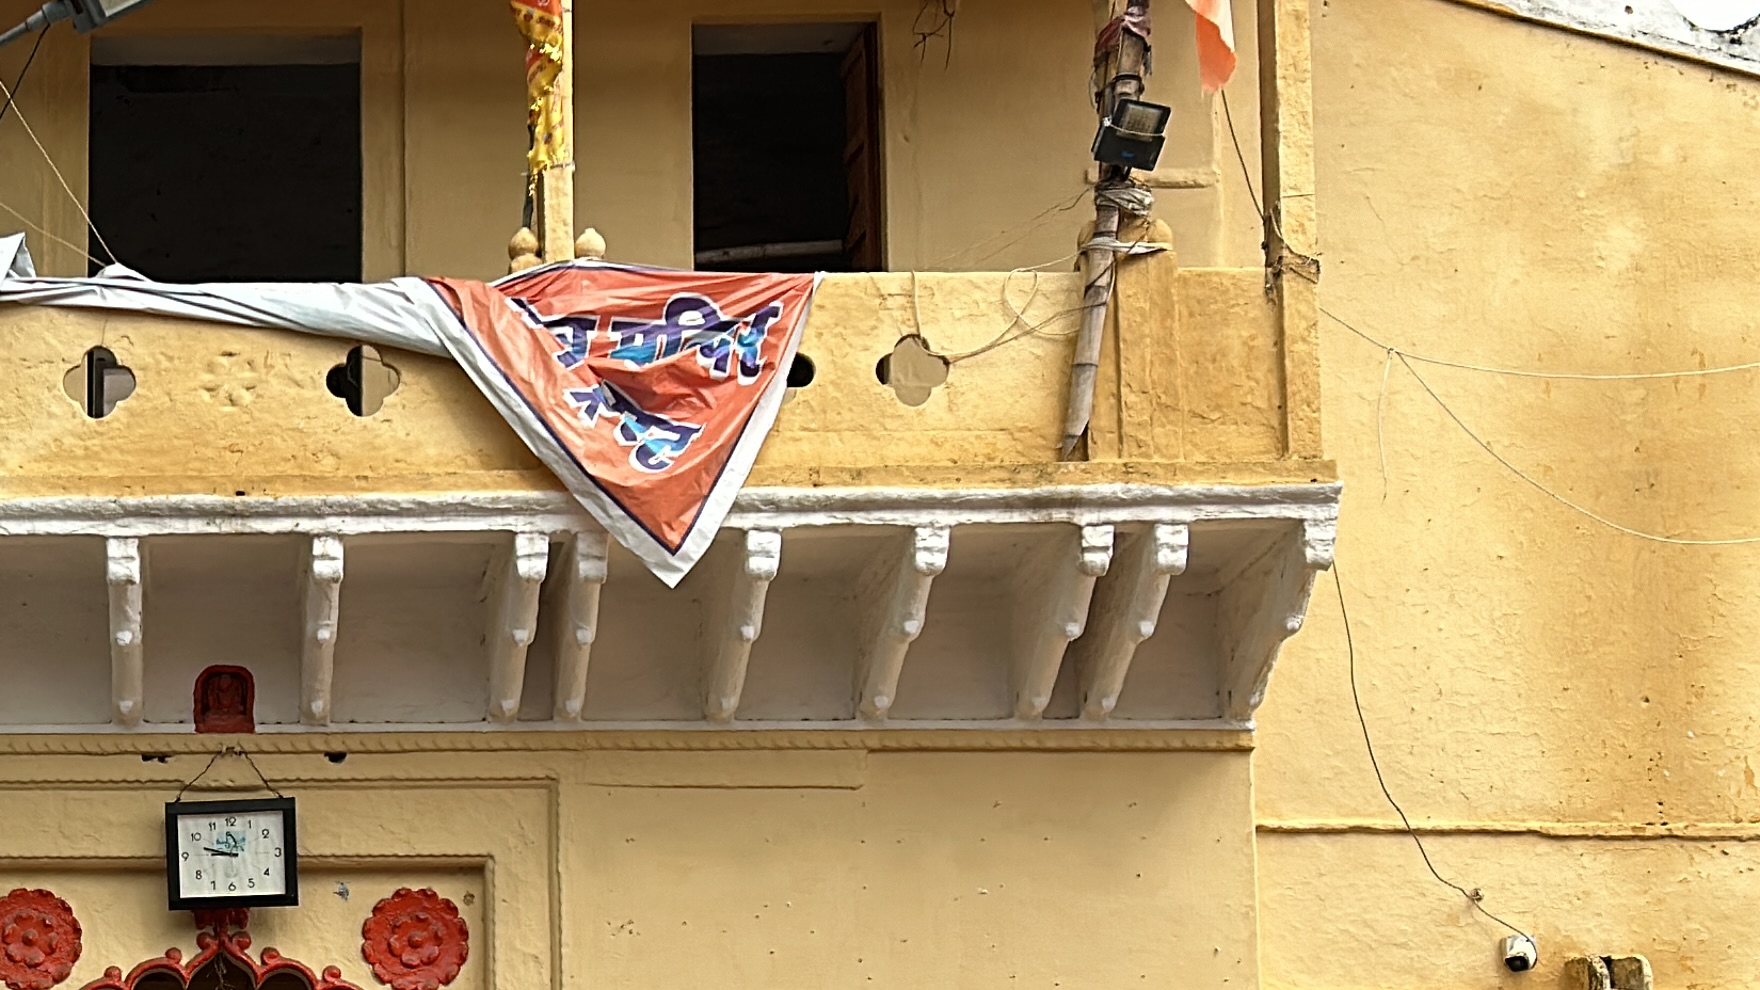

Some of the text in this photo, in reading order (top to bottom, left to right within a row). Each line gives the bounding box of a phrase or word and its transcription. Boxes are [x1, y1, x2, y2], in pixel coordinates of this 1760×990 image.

[208, 822, 216, 831] 11
[225, 817, 237, 827] 12
[248, 820, 252, 829] 1
[191, 832, 202, 842] 10
[262, 829, 270, 839] 2
[181, 851, 190, 861] 9
[274, 847, 282, 858] 3
[195, 870, 203, 880] 8
[263, 867, 270, 876] 4
[228, 882, 237, 891] 6
[248, 878, 256, 888] 5
